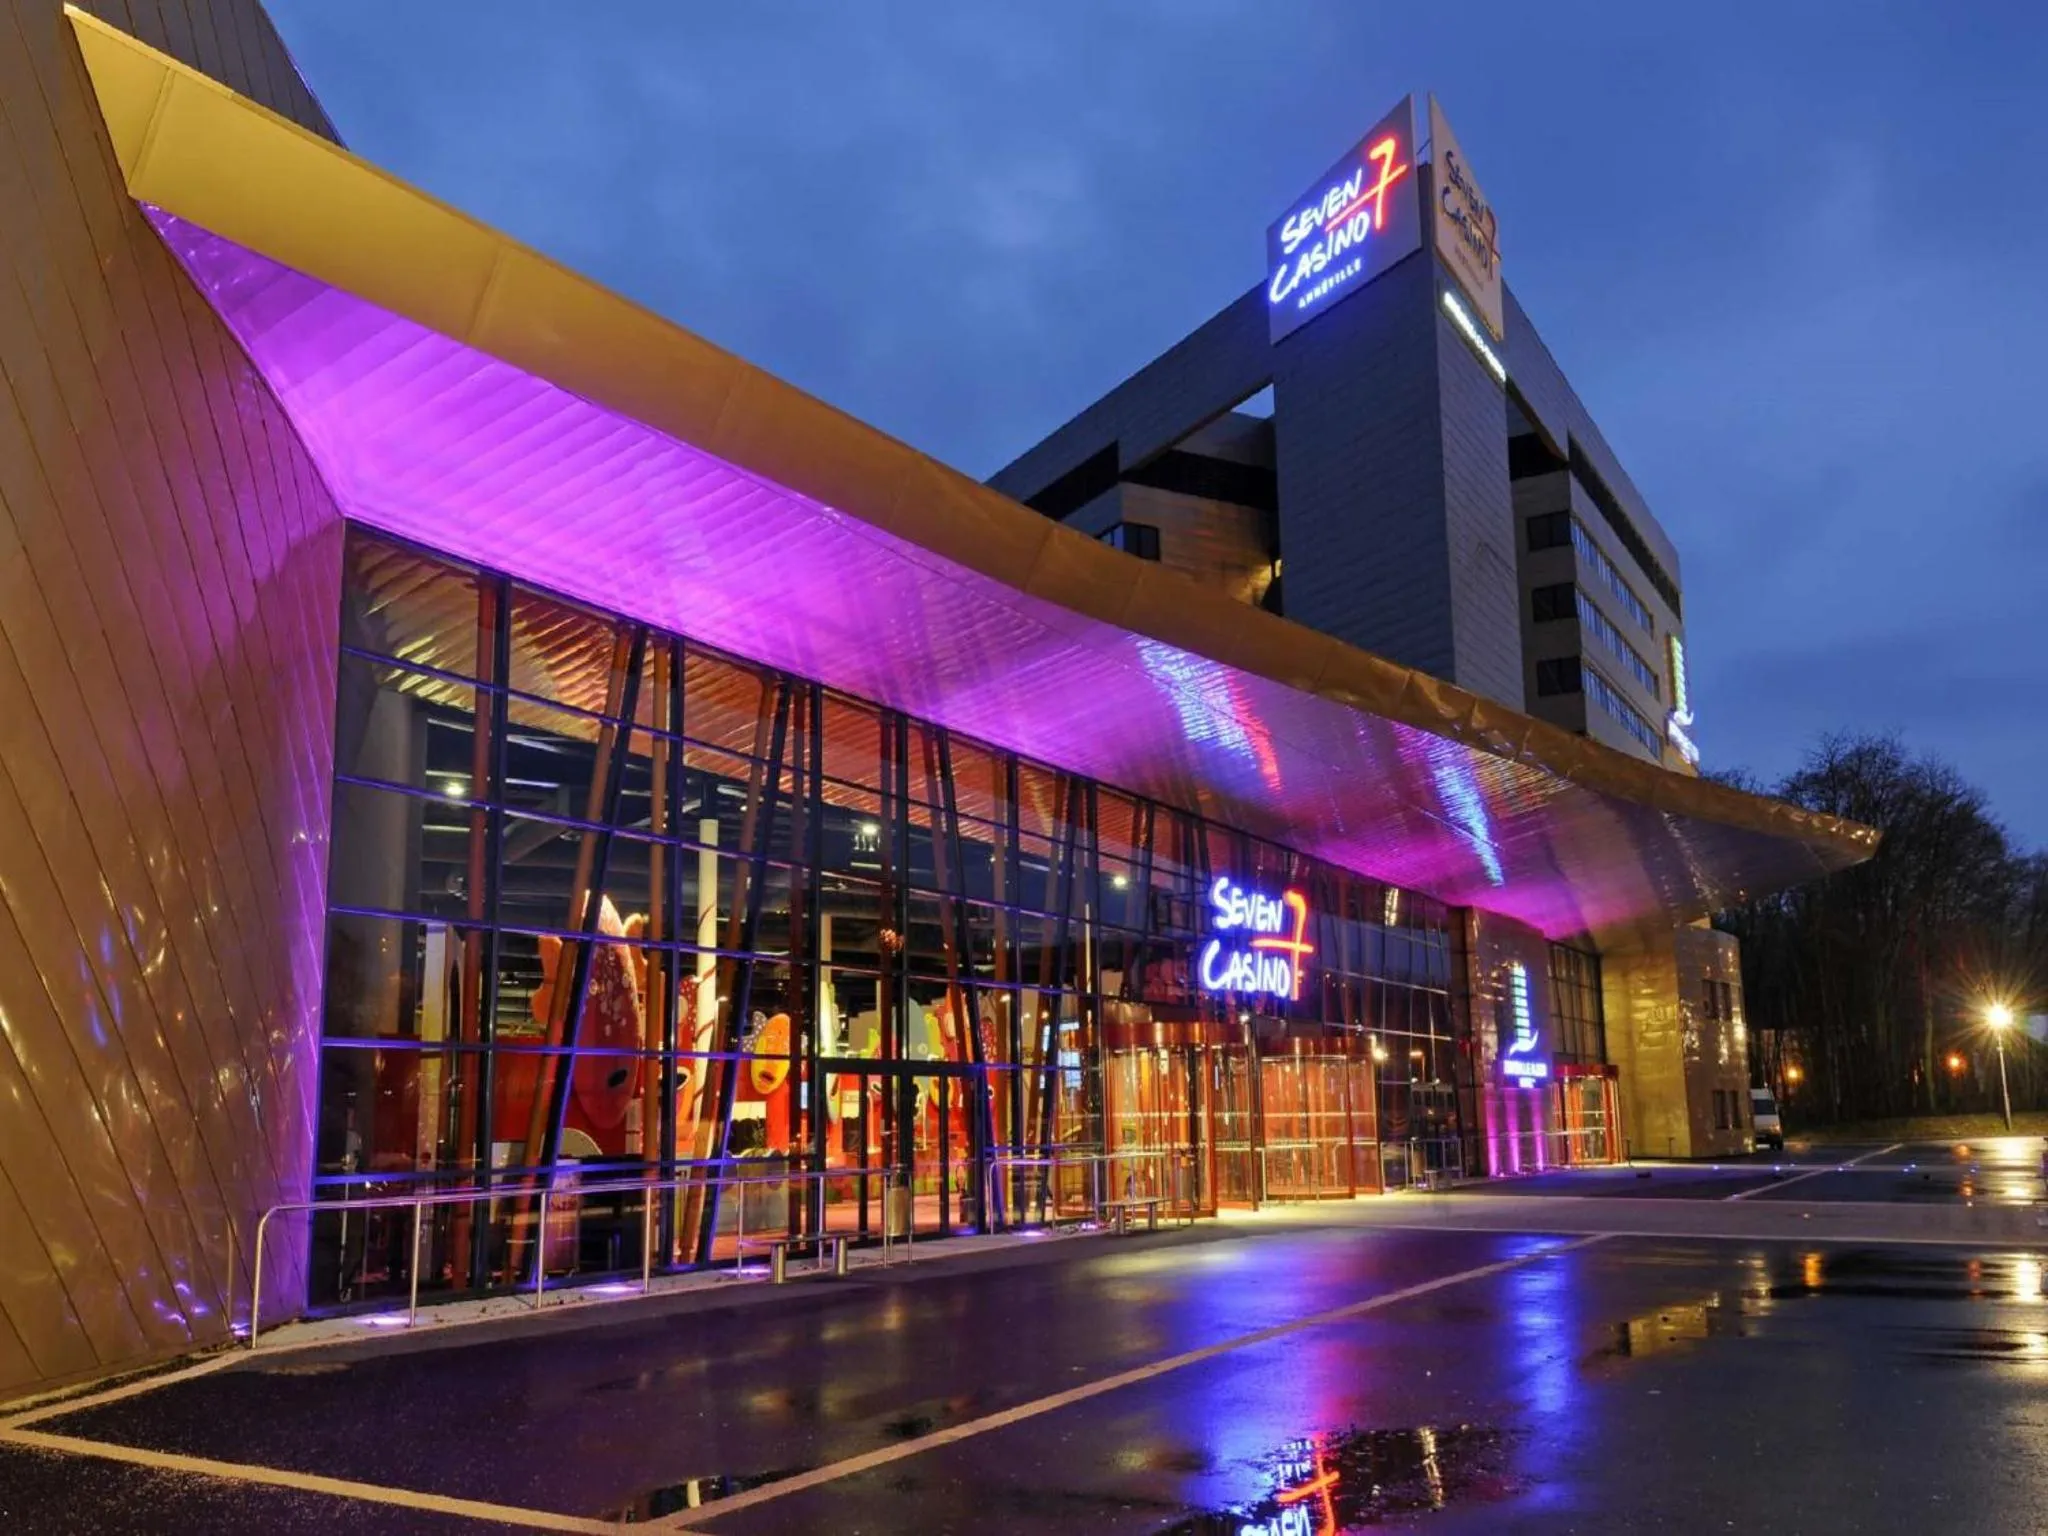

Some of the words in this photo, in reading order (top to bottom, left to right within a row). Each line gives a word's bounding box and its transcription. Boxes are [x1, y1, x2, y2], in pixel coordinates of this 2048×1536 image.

[1280, 167, 1363, 255] SEVEN
[1268, 210, 1371, 305] CASINO
[1211, 876, 1284, 933] SEVEN
[1201, 939, 1291, 999] CASINO
